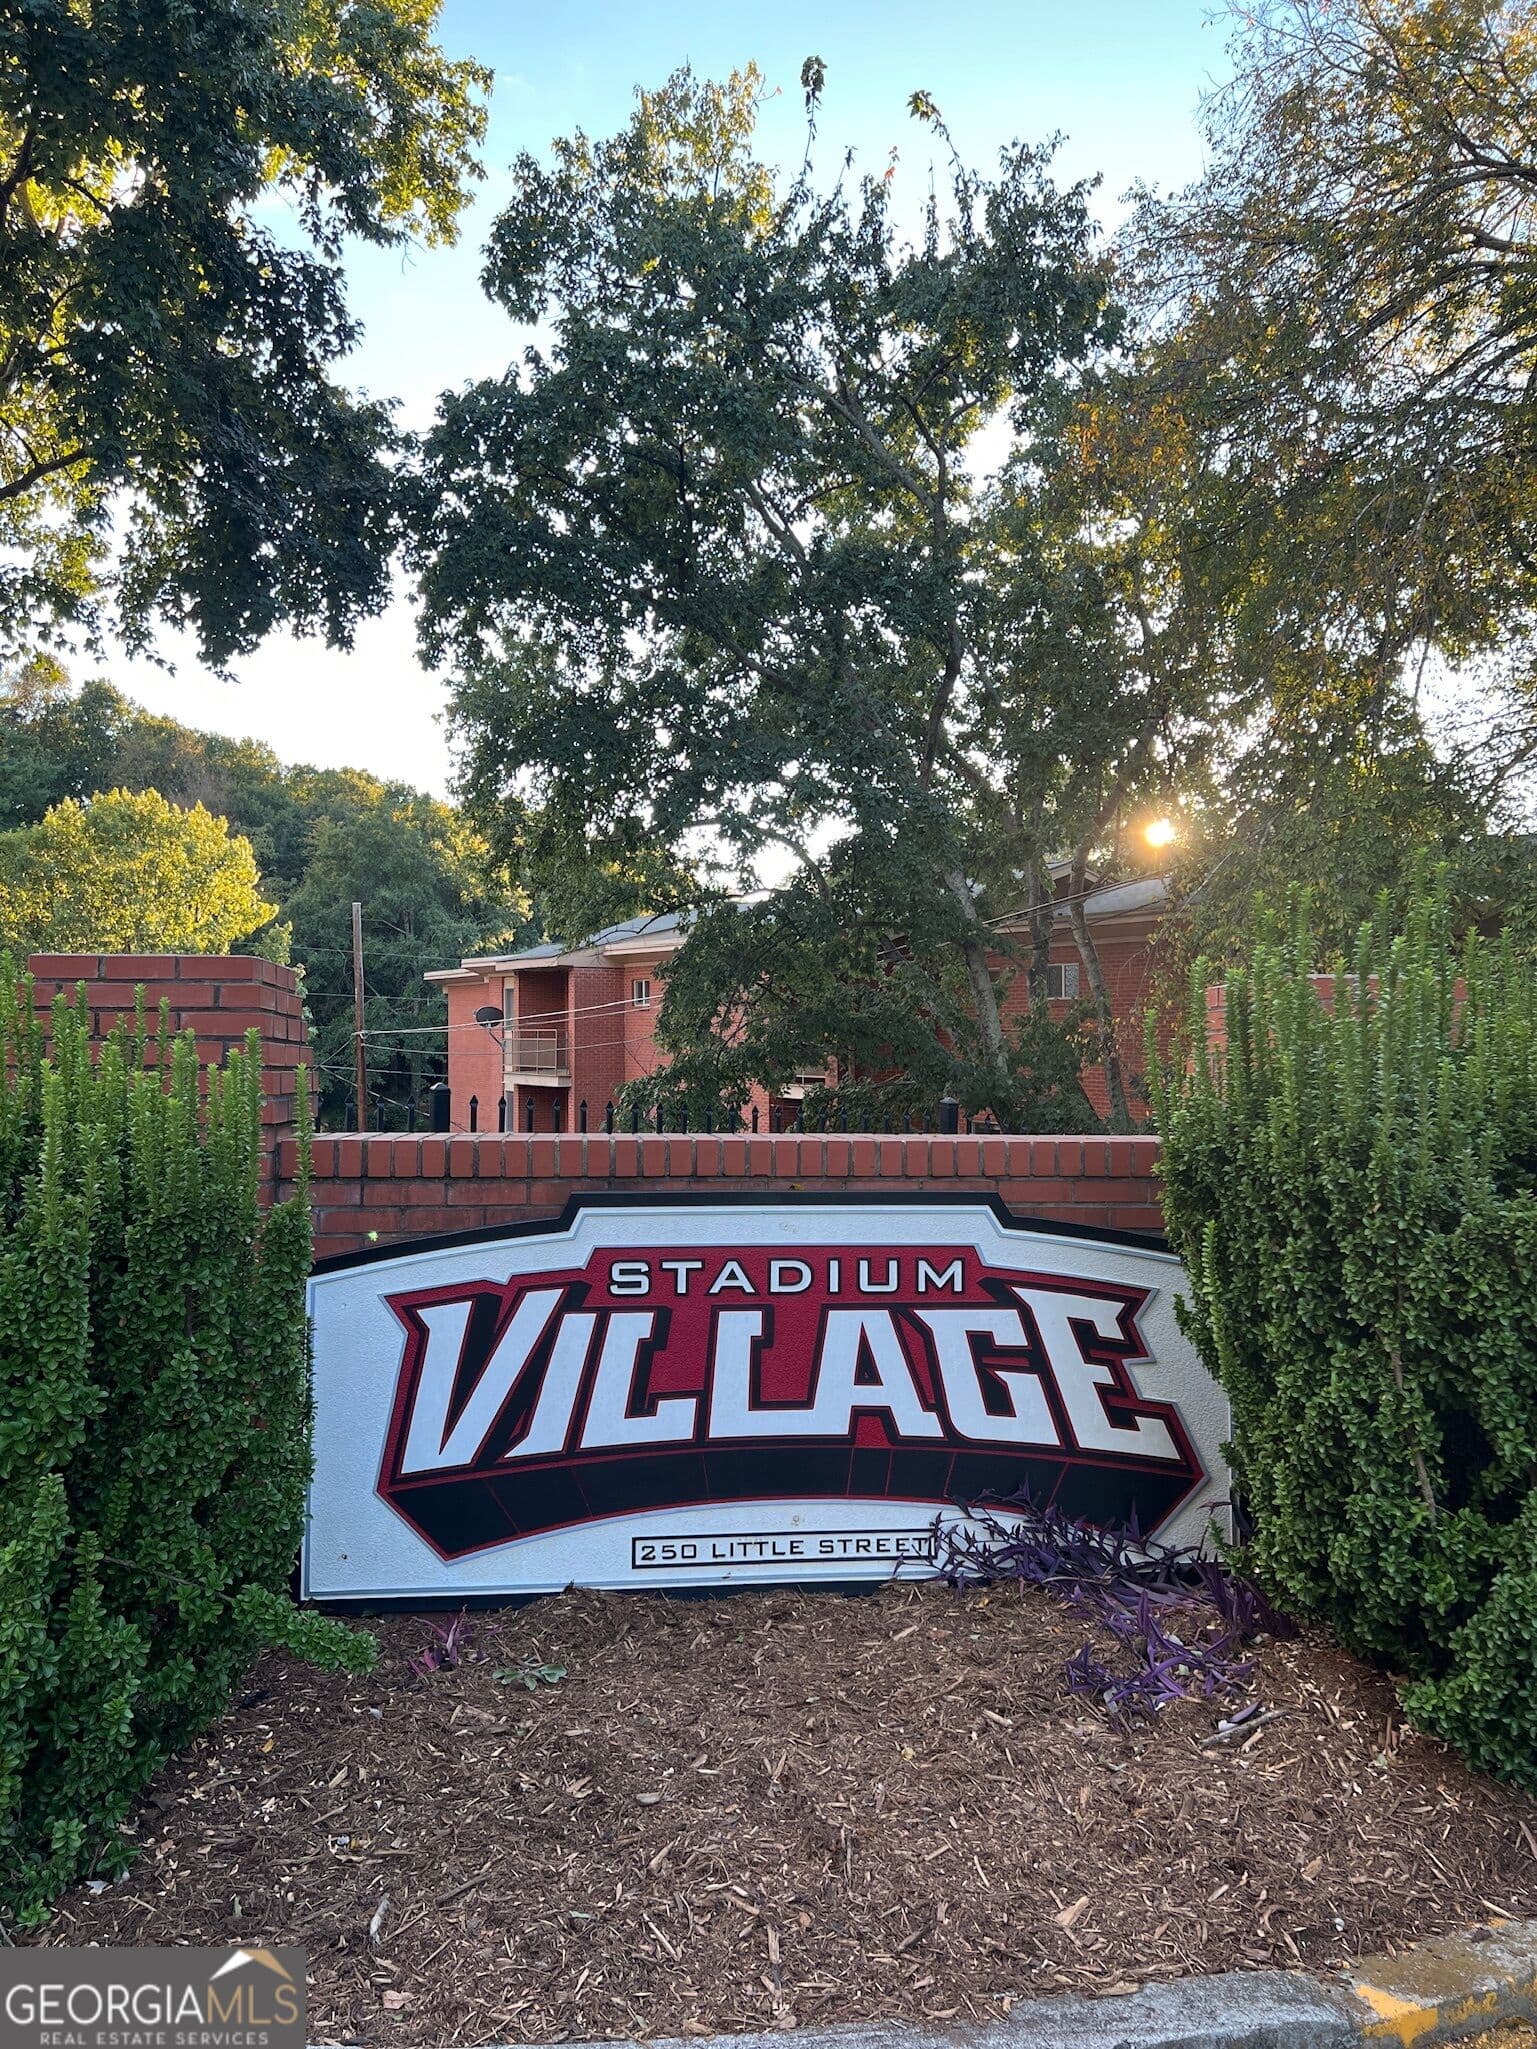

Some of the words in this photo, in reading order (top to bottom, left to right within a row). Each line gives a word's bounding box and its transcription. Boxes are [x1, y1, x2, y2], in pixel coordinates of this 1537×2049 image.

[608, 1258, 965, 1296] STADIUM
[400, 1286, 1183, 1475] VILLAGE
[640, 1543, 698, 1561] 250
[711, 1540, 805, 1558] LITTLE
[818, 1536, 930, 1555] STREET
